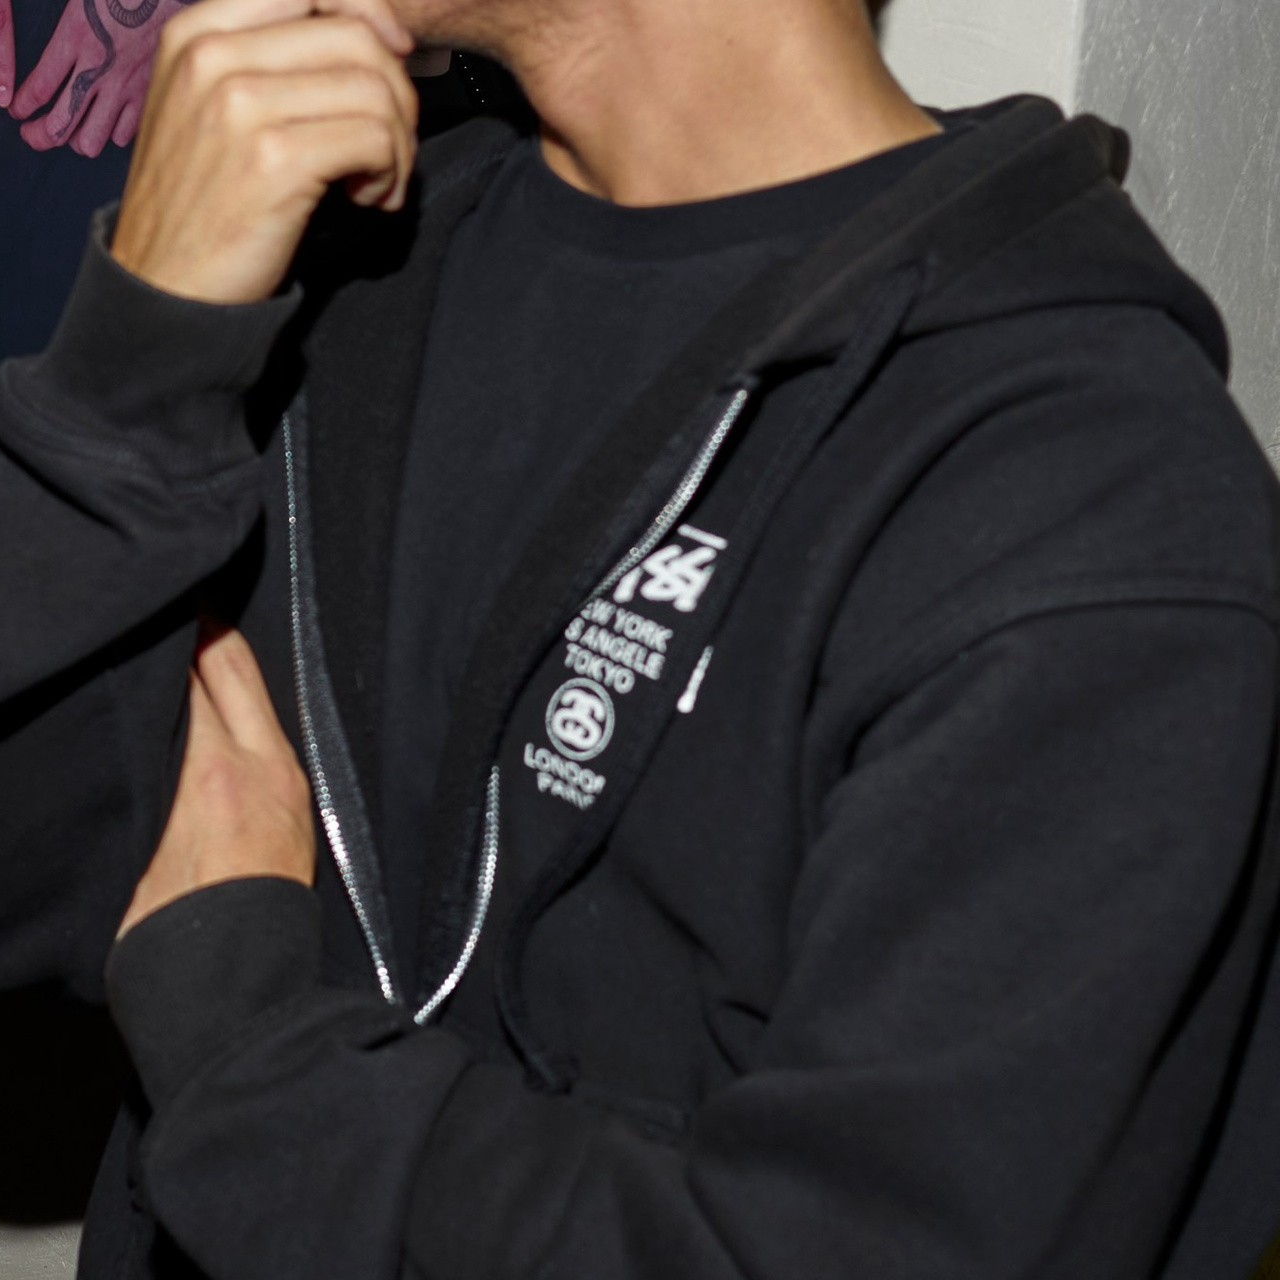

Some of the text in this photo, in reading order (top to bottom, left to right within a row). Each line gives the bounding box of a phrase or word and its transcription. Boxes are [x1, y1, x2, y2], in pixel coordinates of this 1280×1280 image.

[578, 624, 667, 681] ANGELE
[612, 606, 674, 654] YORK
[564, 642, 637, 695] TOKYO
